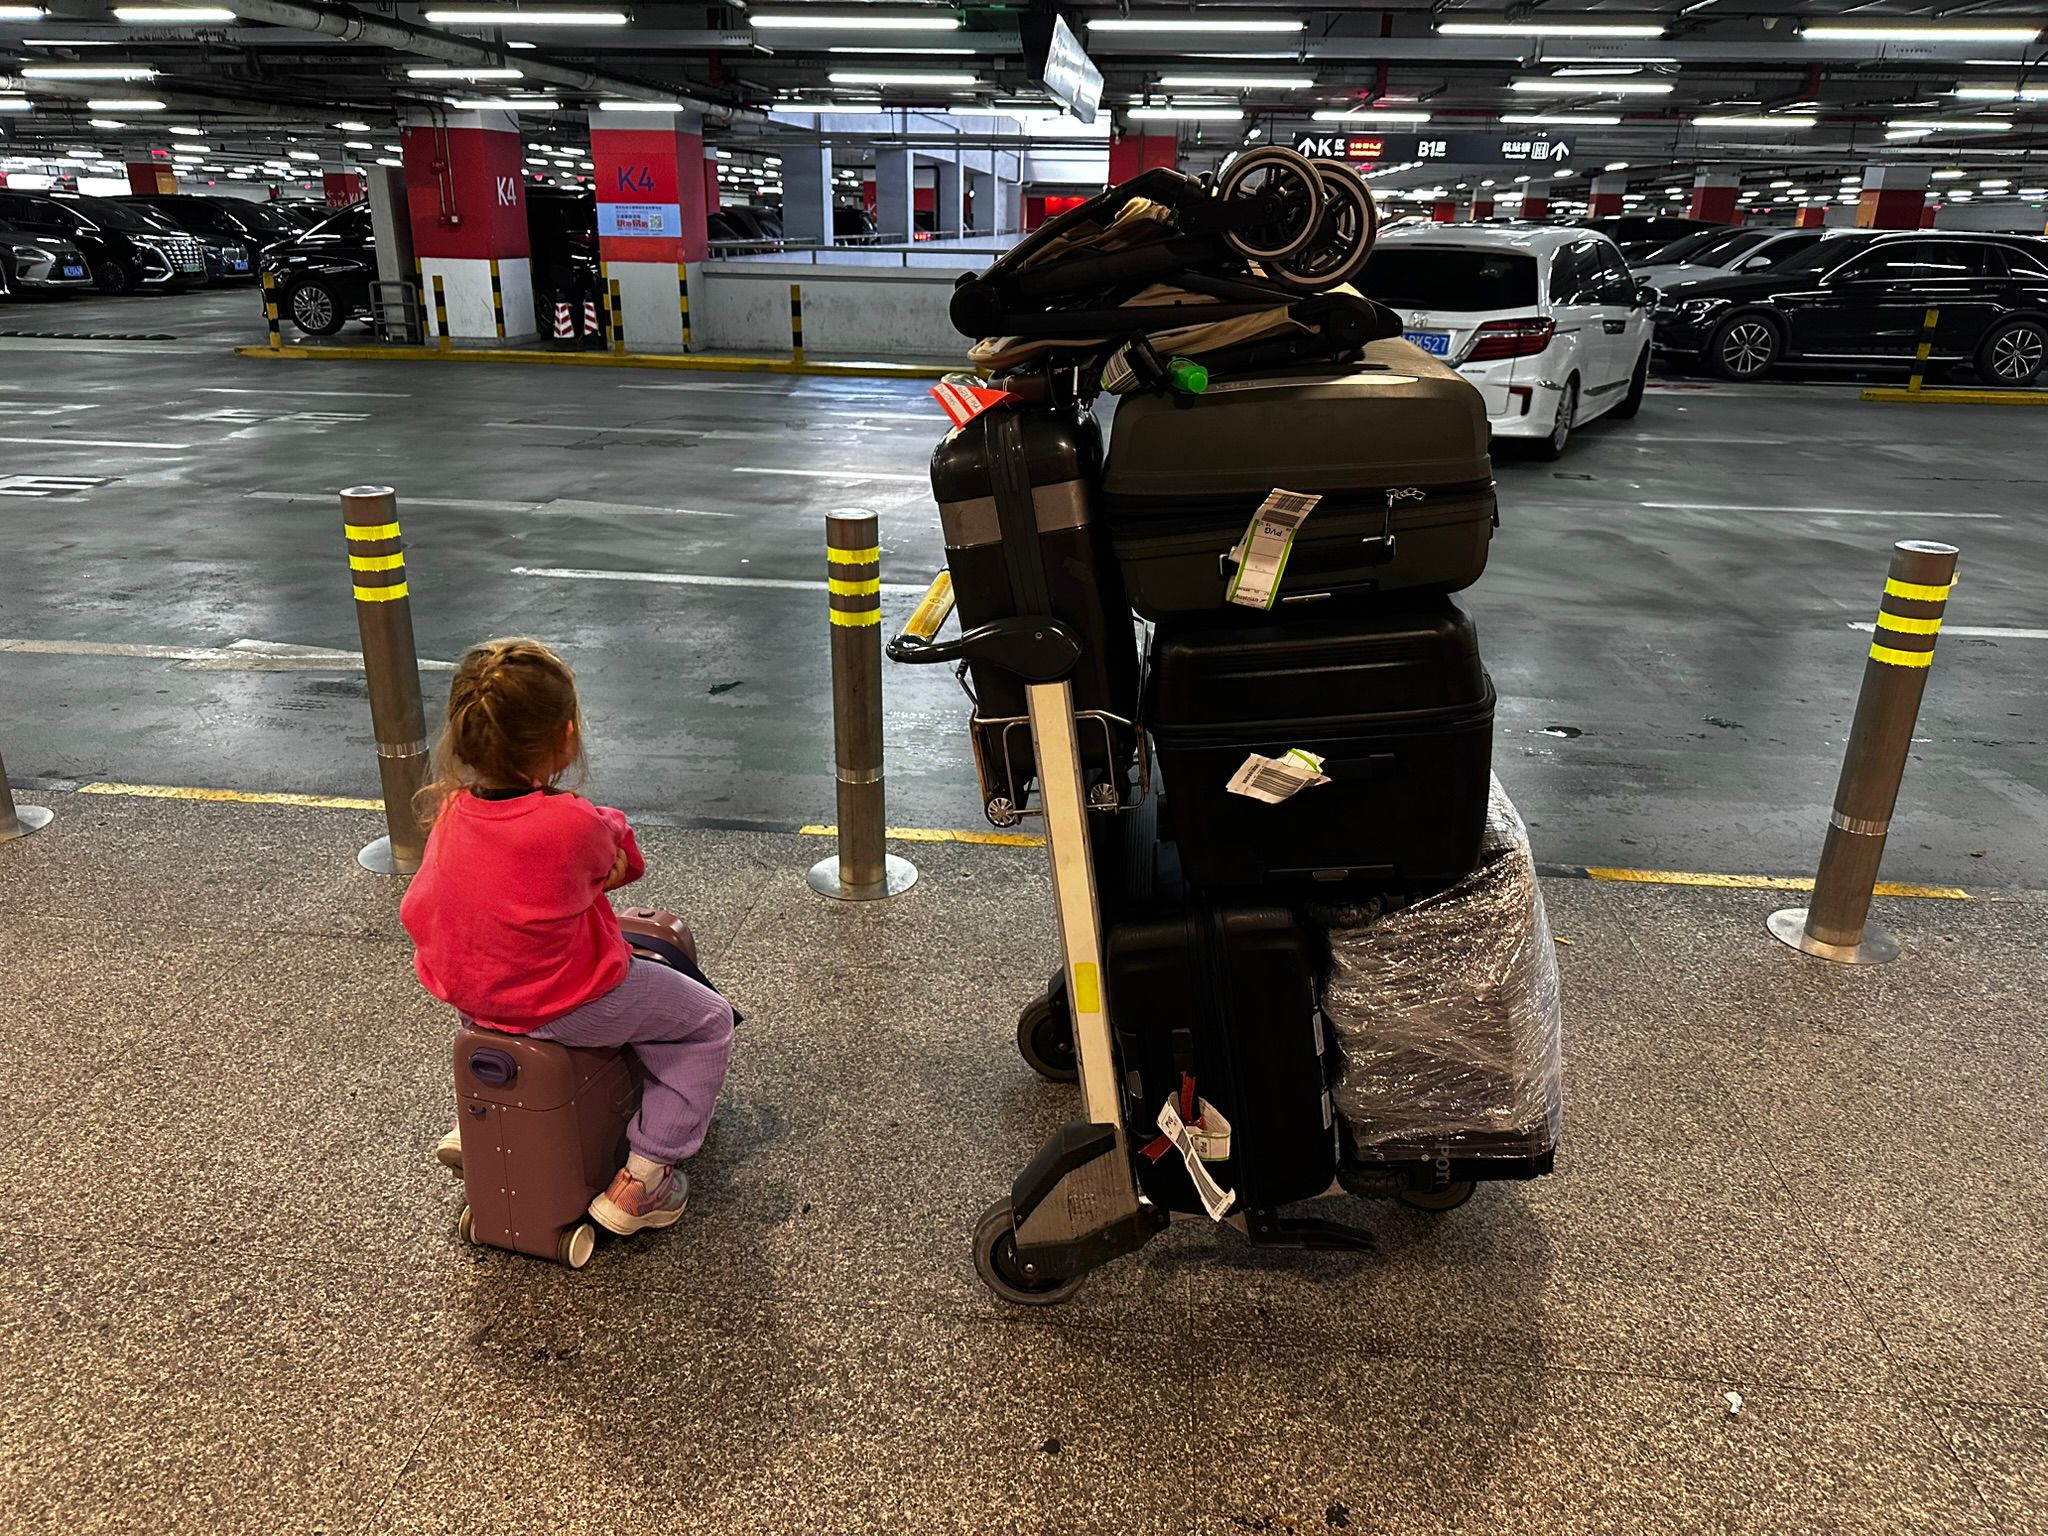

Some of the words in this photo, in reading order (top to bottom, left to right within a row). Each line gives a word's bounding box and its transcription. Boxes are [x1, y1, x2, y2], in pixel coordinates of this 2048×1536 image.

[496, 176, 517, 206] K4
[616, 166, 655, 193] K4
[1264, 527, 1283, 537] PVG
